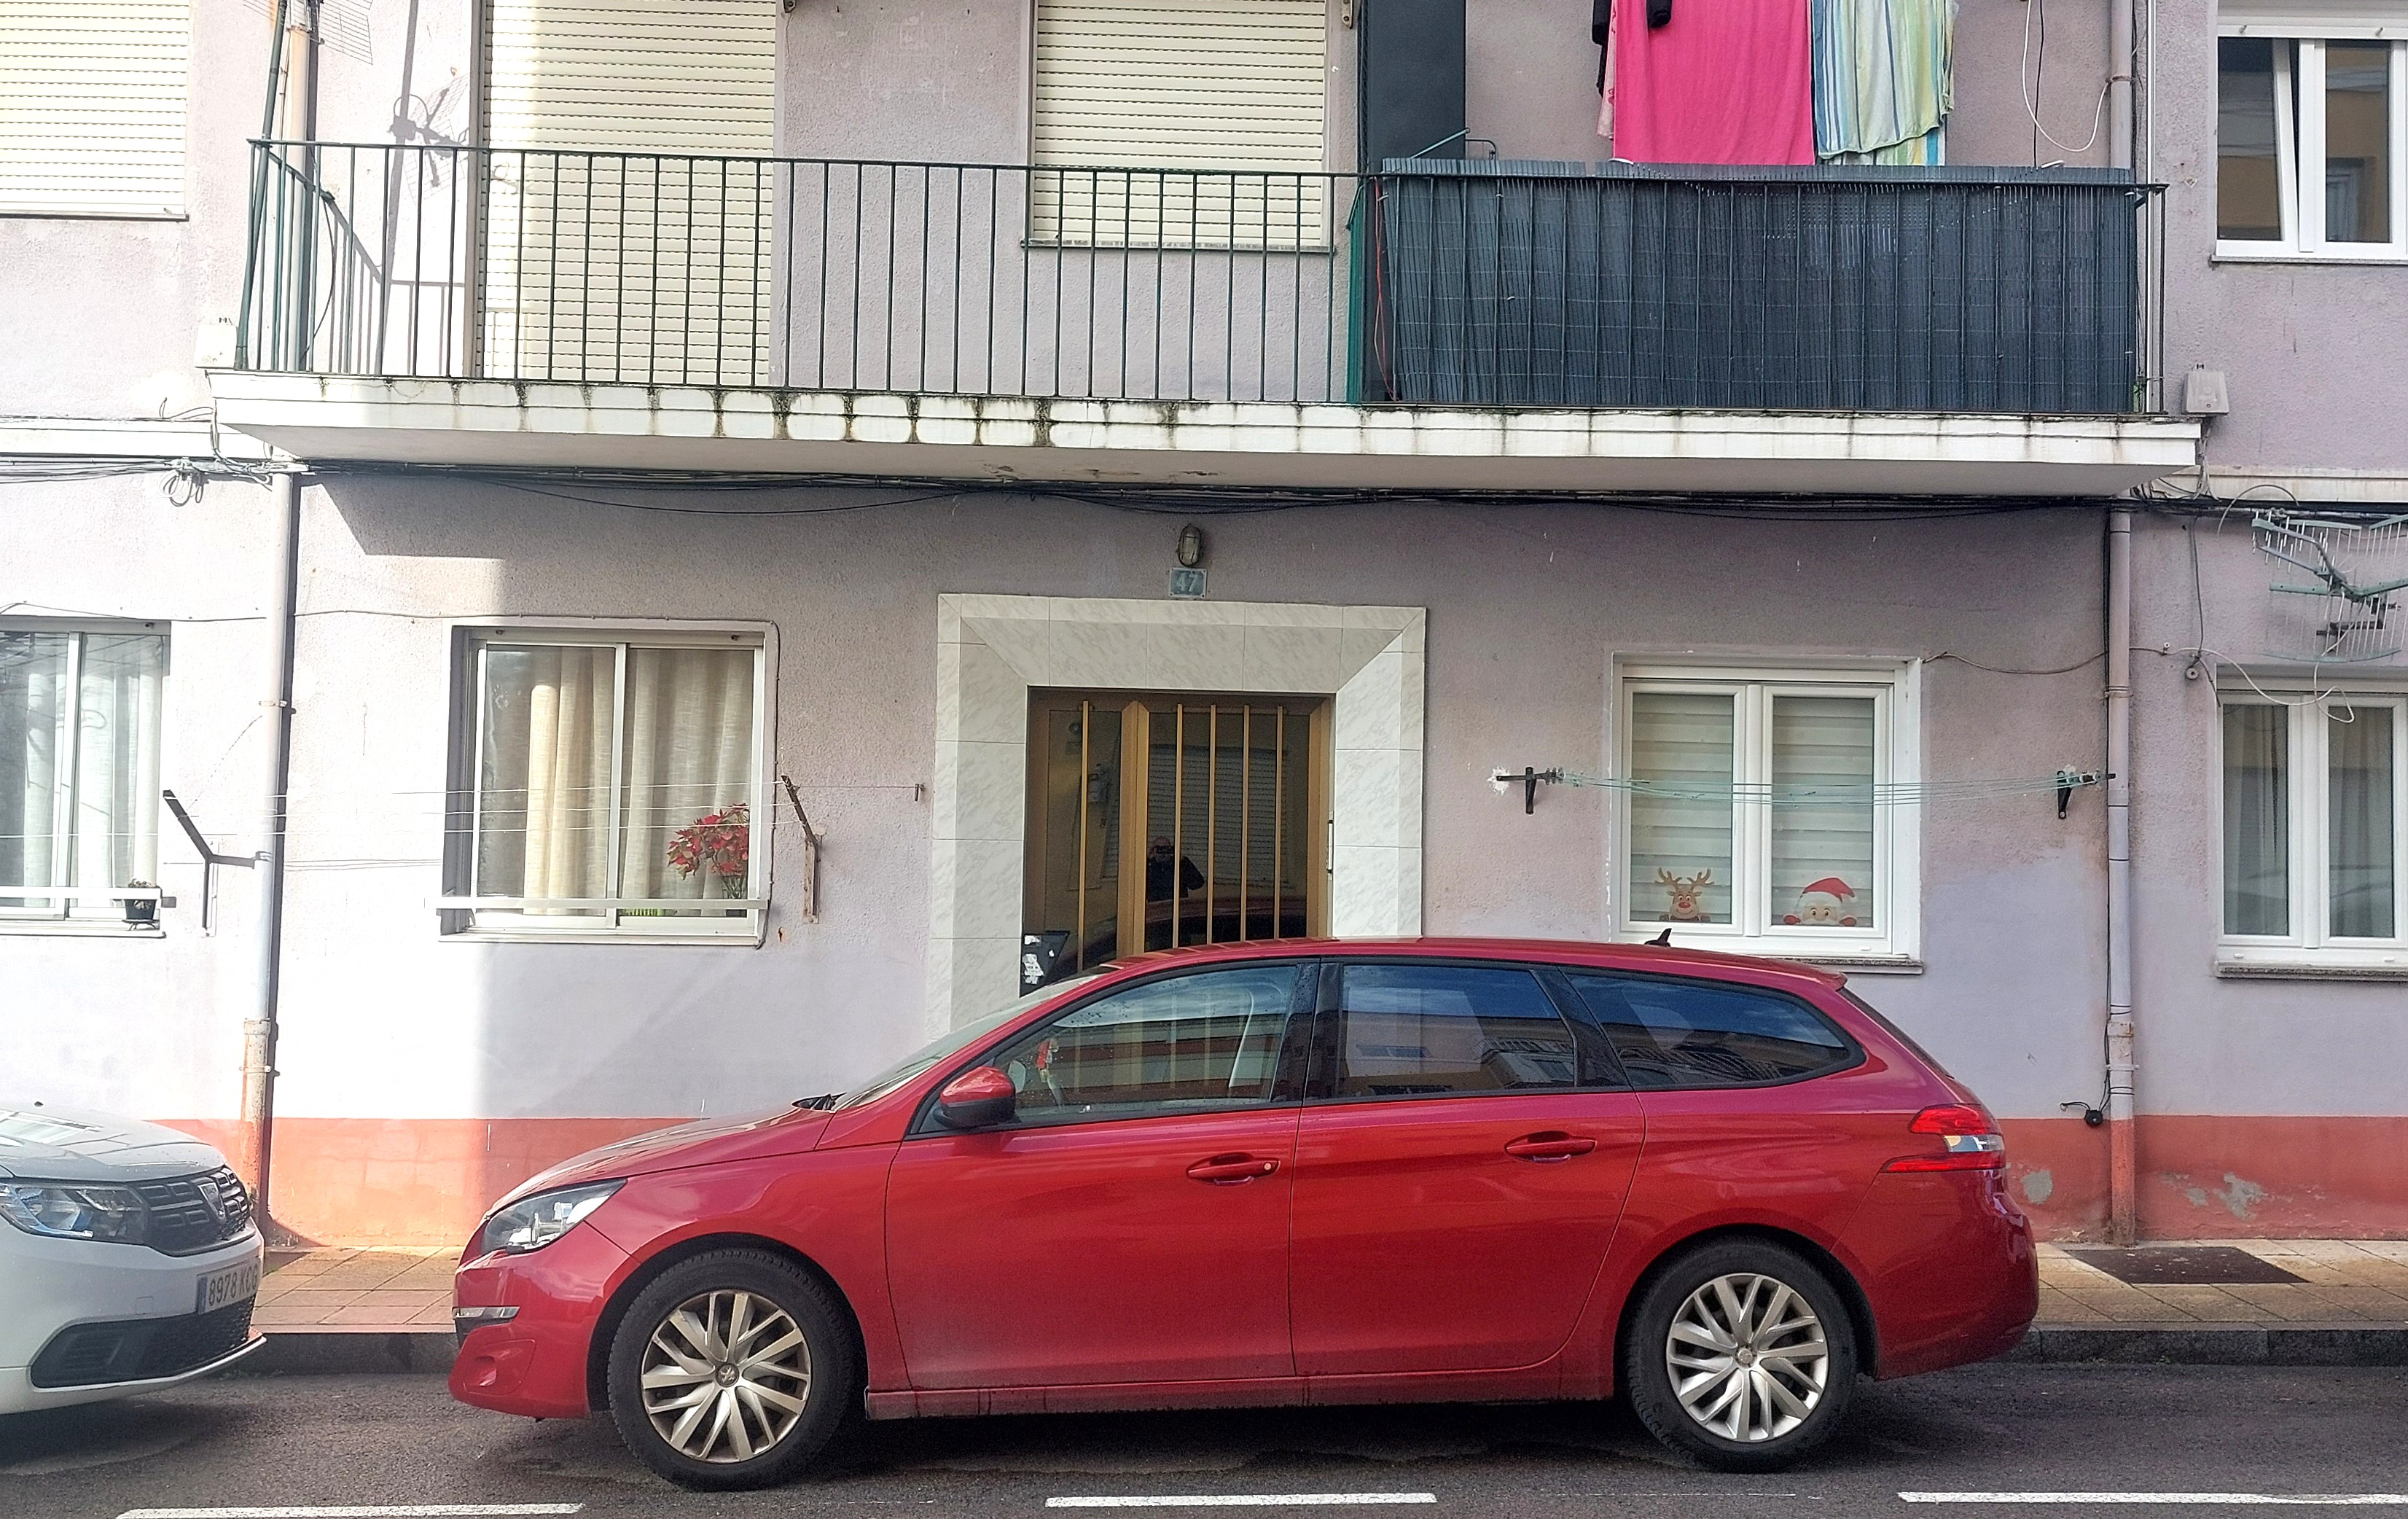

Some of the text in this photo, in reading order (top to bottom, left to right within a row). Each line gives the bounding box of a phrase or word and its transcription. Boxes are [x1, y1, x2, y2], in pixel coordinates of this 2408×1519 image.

[1176, 571, 1198, 592] 47
[208, 1264, 258, 1306] 8978 KCG
